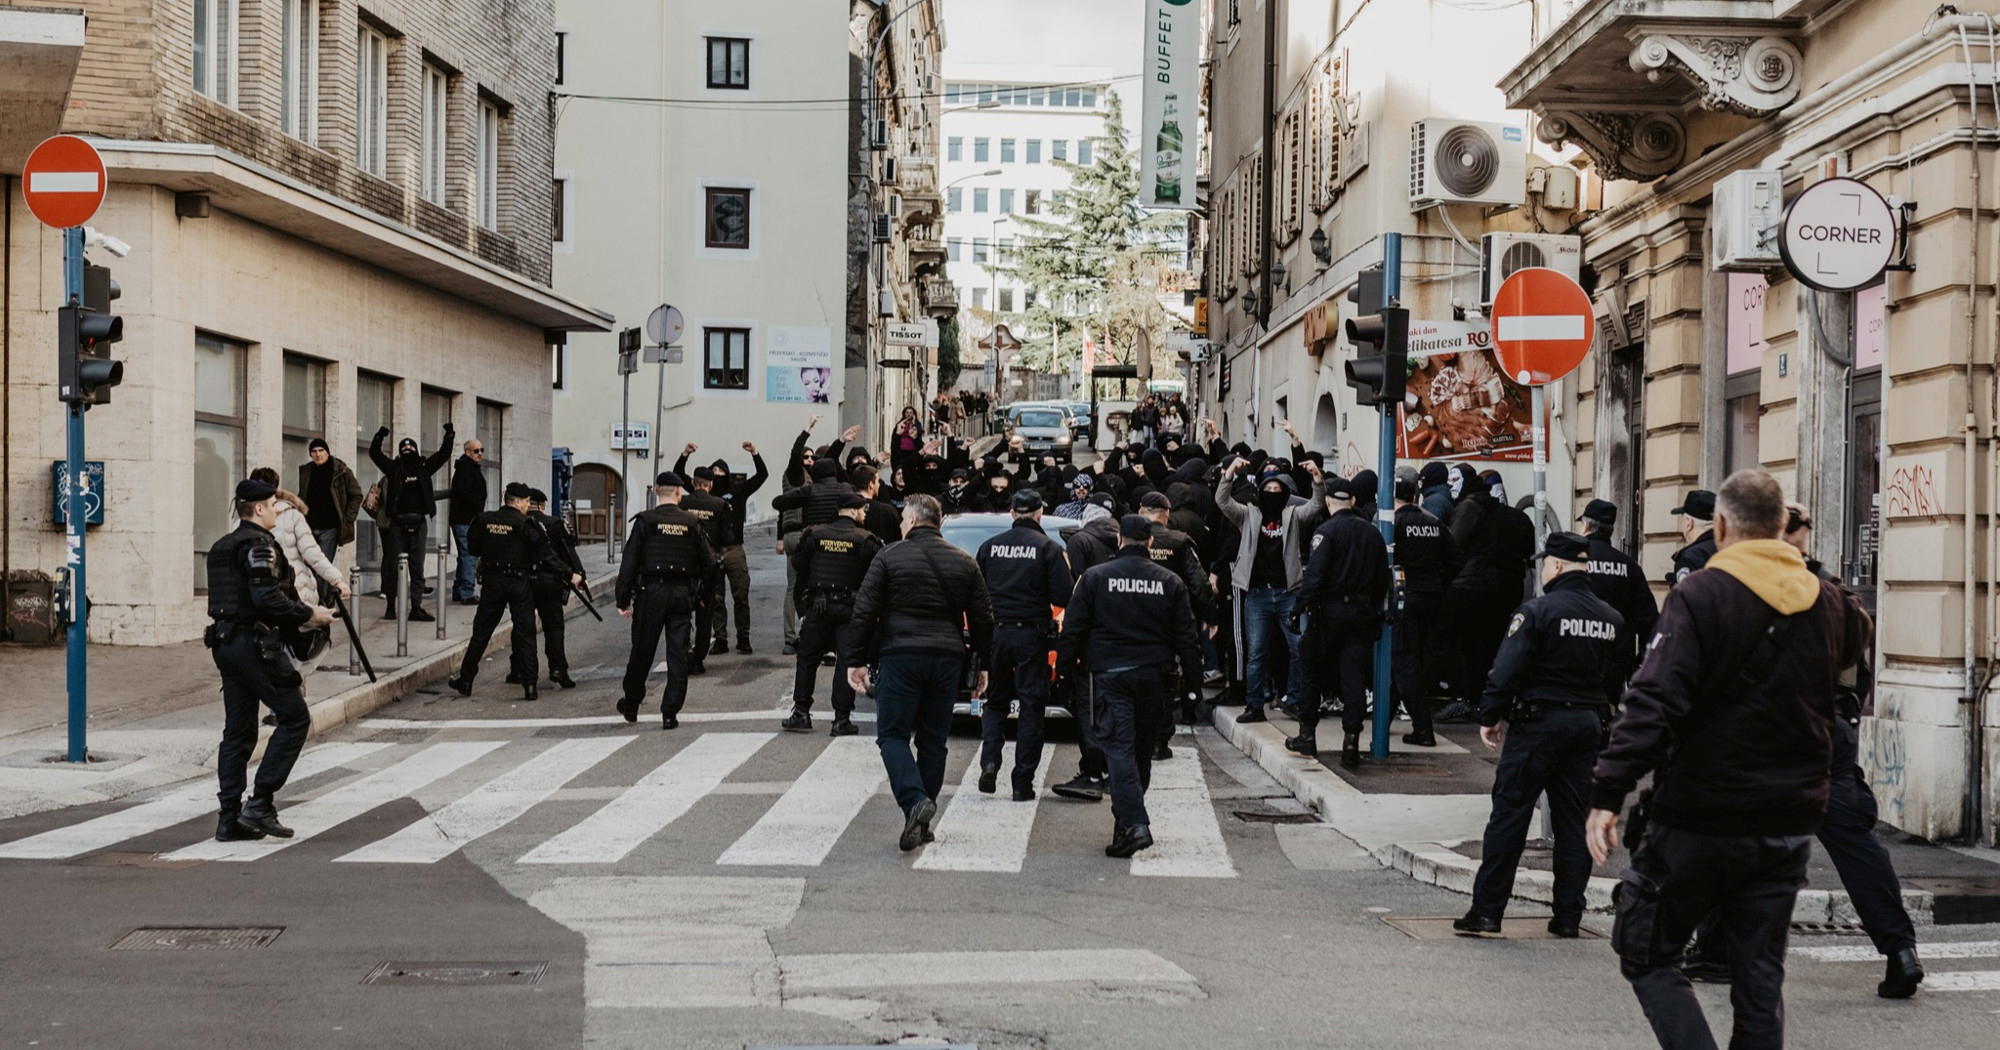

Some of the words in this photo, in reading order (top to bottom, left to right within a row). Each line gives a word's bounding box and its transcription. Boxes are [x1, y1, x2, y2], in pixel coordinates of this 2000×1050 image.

[1157, 8, 1172, 84] BUFFET
[1798, 224, 1881, 244] CORNER
[1559, 246, 1578, 254] Midea
[890, 331, 923, 339] TISSOT
[1408, 328, 1421, 336] aki
[1423, 326, 1438, 335] dan
[1407, 337, 1462, 352] elikatesa
[1466, 331, 1491, 348] RO
[820, 539, 853, 548] INTERVENTNA
[991, 545, 1036, 559] POLICIJA
[1586, 560, 1628, 577] OLICIJA
[1108, 578, 1164, 595] POLICIJA
[1560, 619, 1616, 641] POLICIJA
